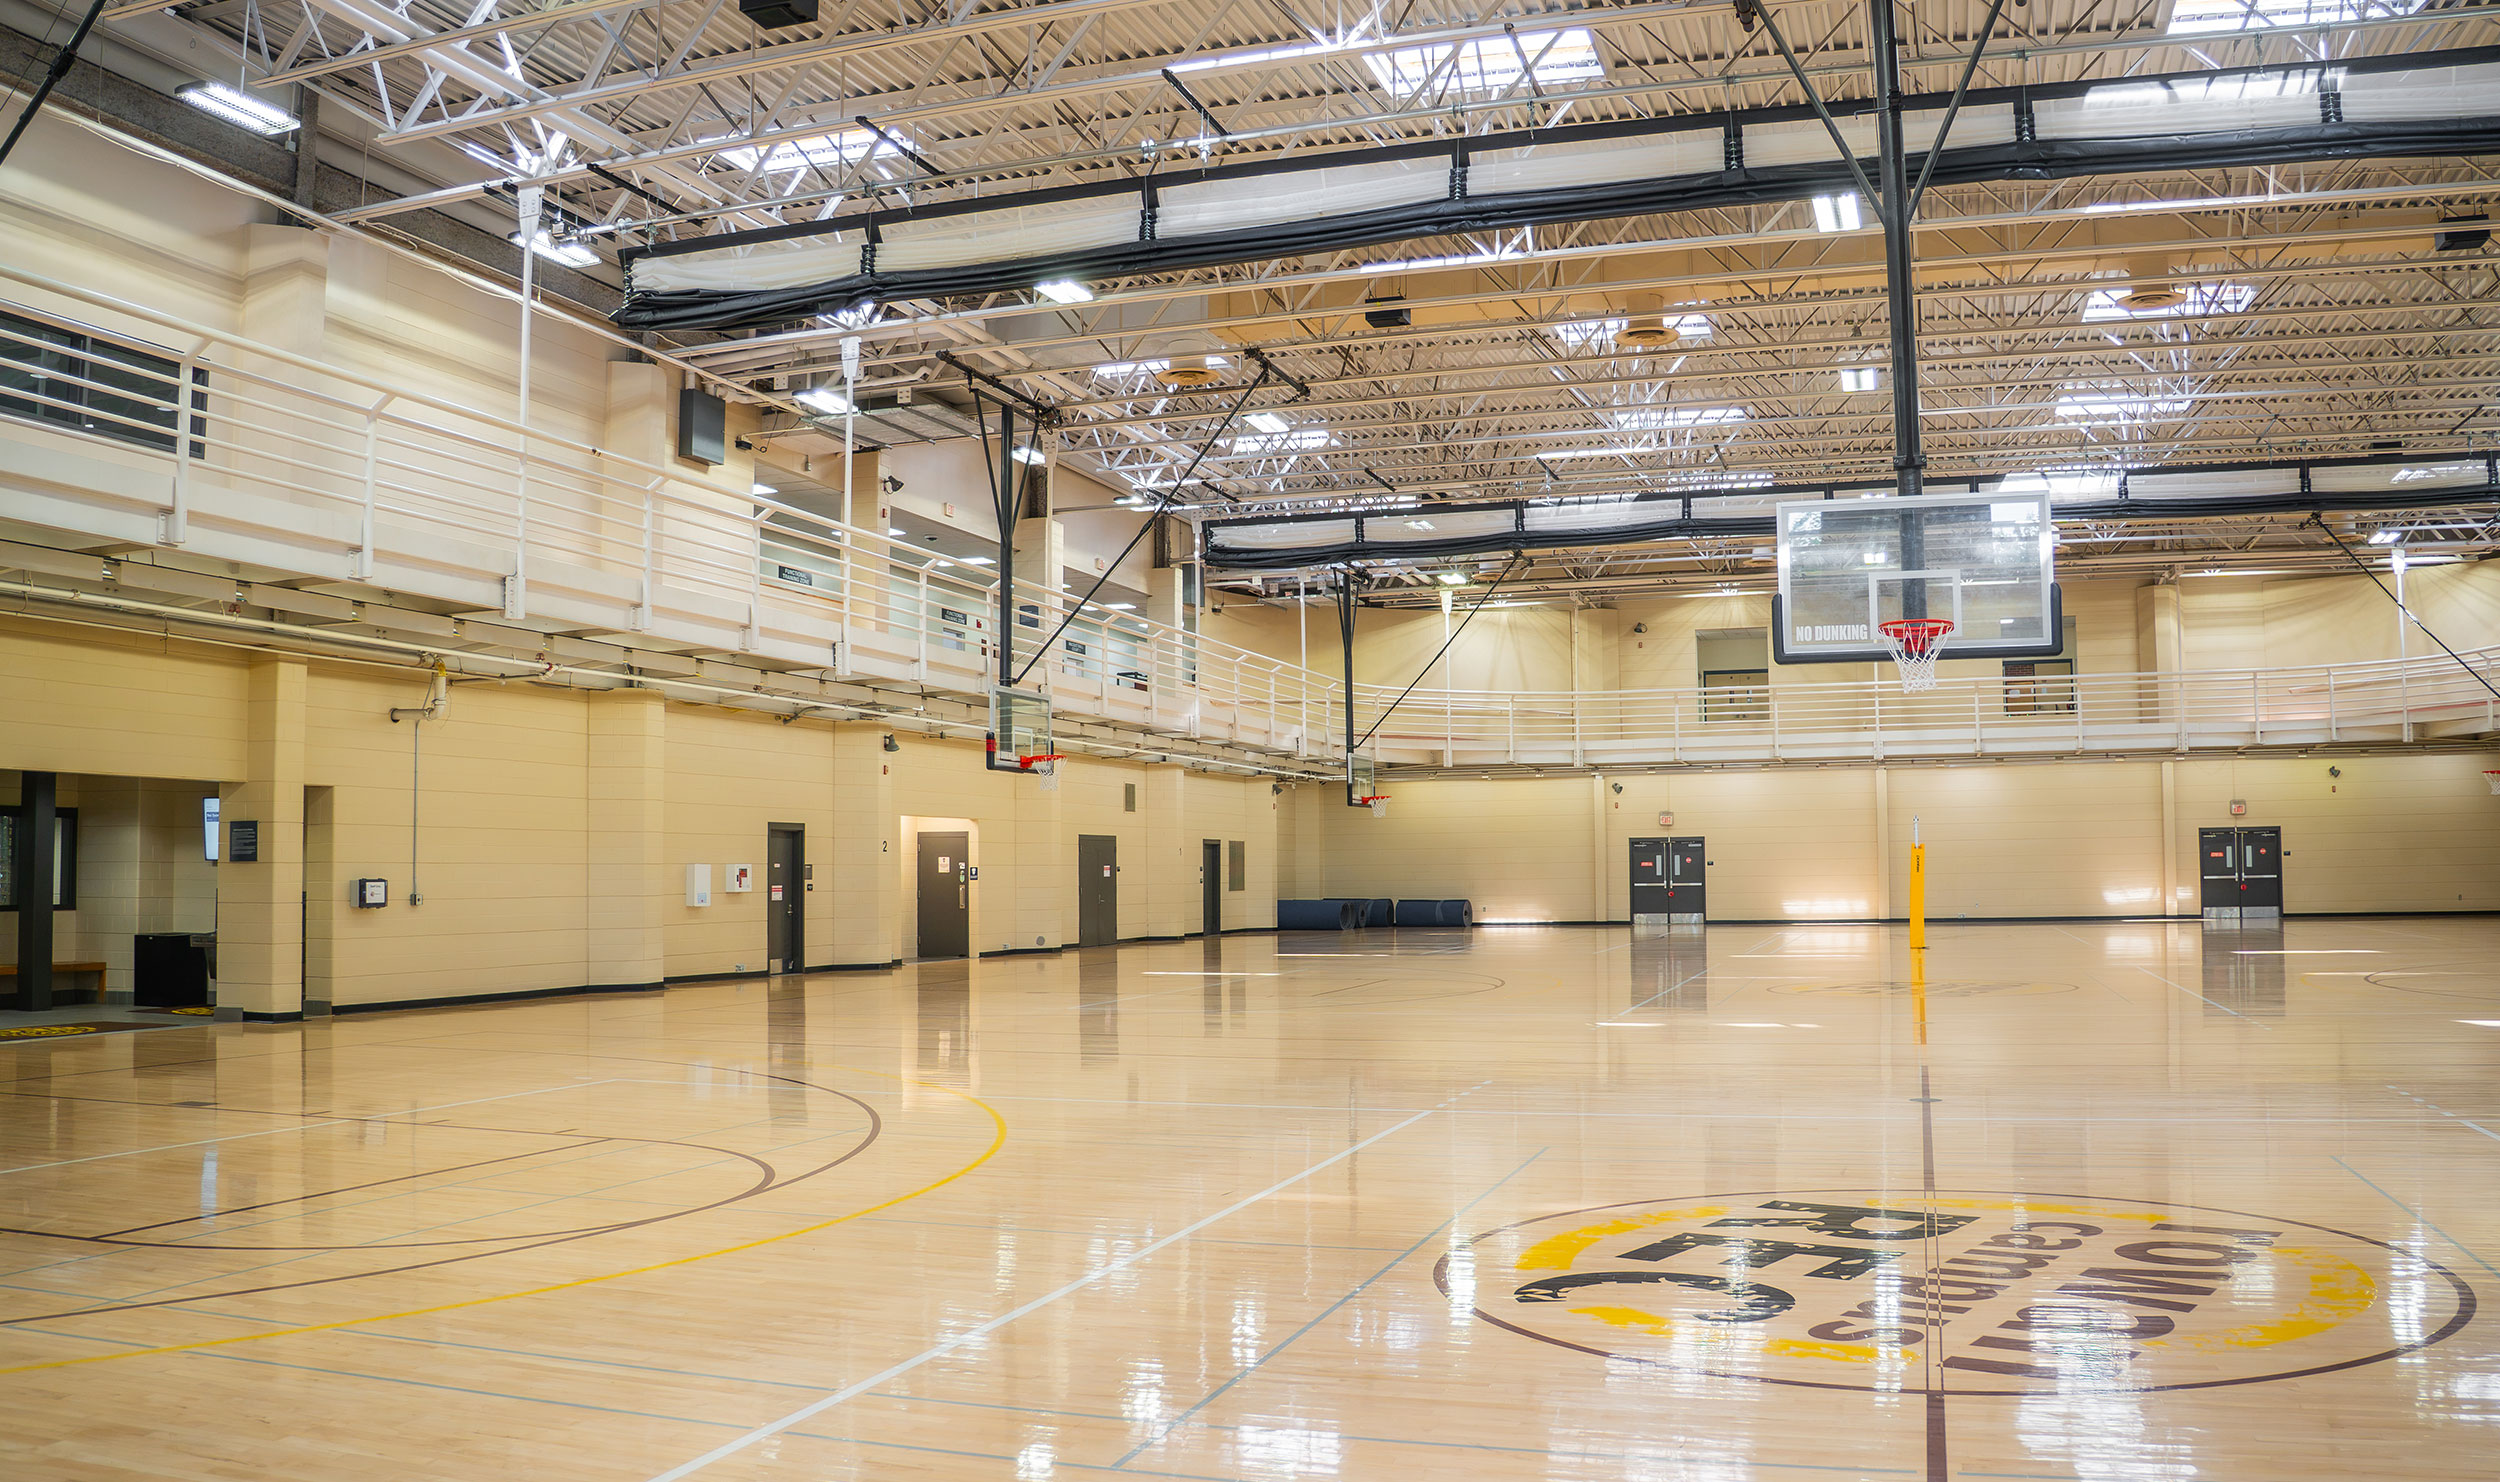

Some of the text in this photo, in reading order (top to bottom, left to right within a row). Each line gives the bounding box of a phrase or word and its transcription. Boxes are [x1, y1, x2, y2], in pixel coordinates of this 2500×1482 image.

[782, 573, 800, 583] TRAINING
[784, 568, 808, 580] FUNCTIONAL
[1795, 623, 1868, 642] NO DUNKING
[1661, 815, 1672, 824] EXIT
[882, 840, 888, 853] 2
[1513, 1199, 1981, 1322] REC
[1807, 1220, 2105, 1348] campus
[1940, 1222, 2284, 1381] rowan
